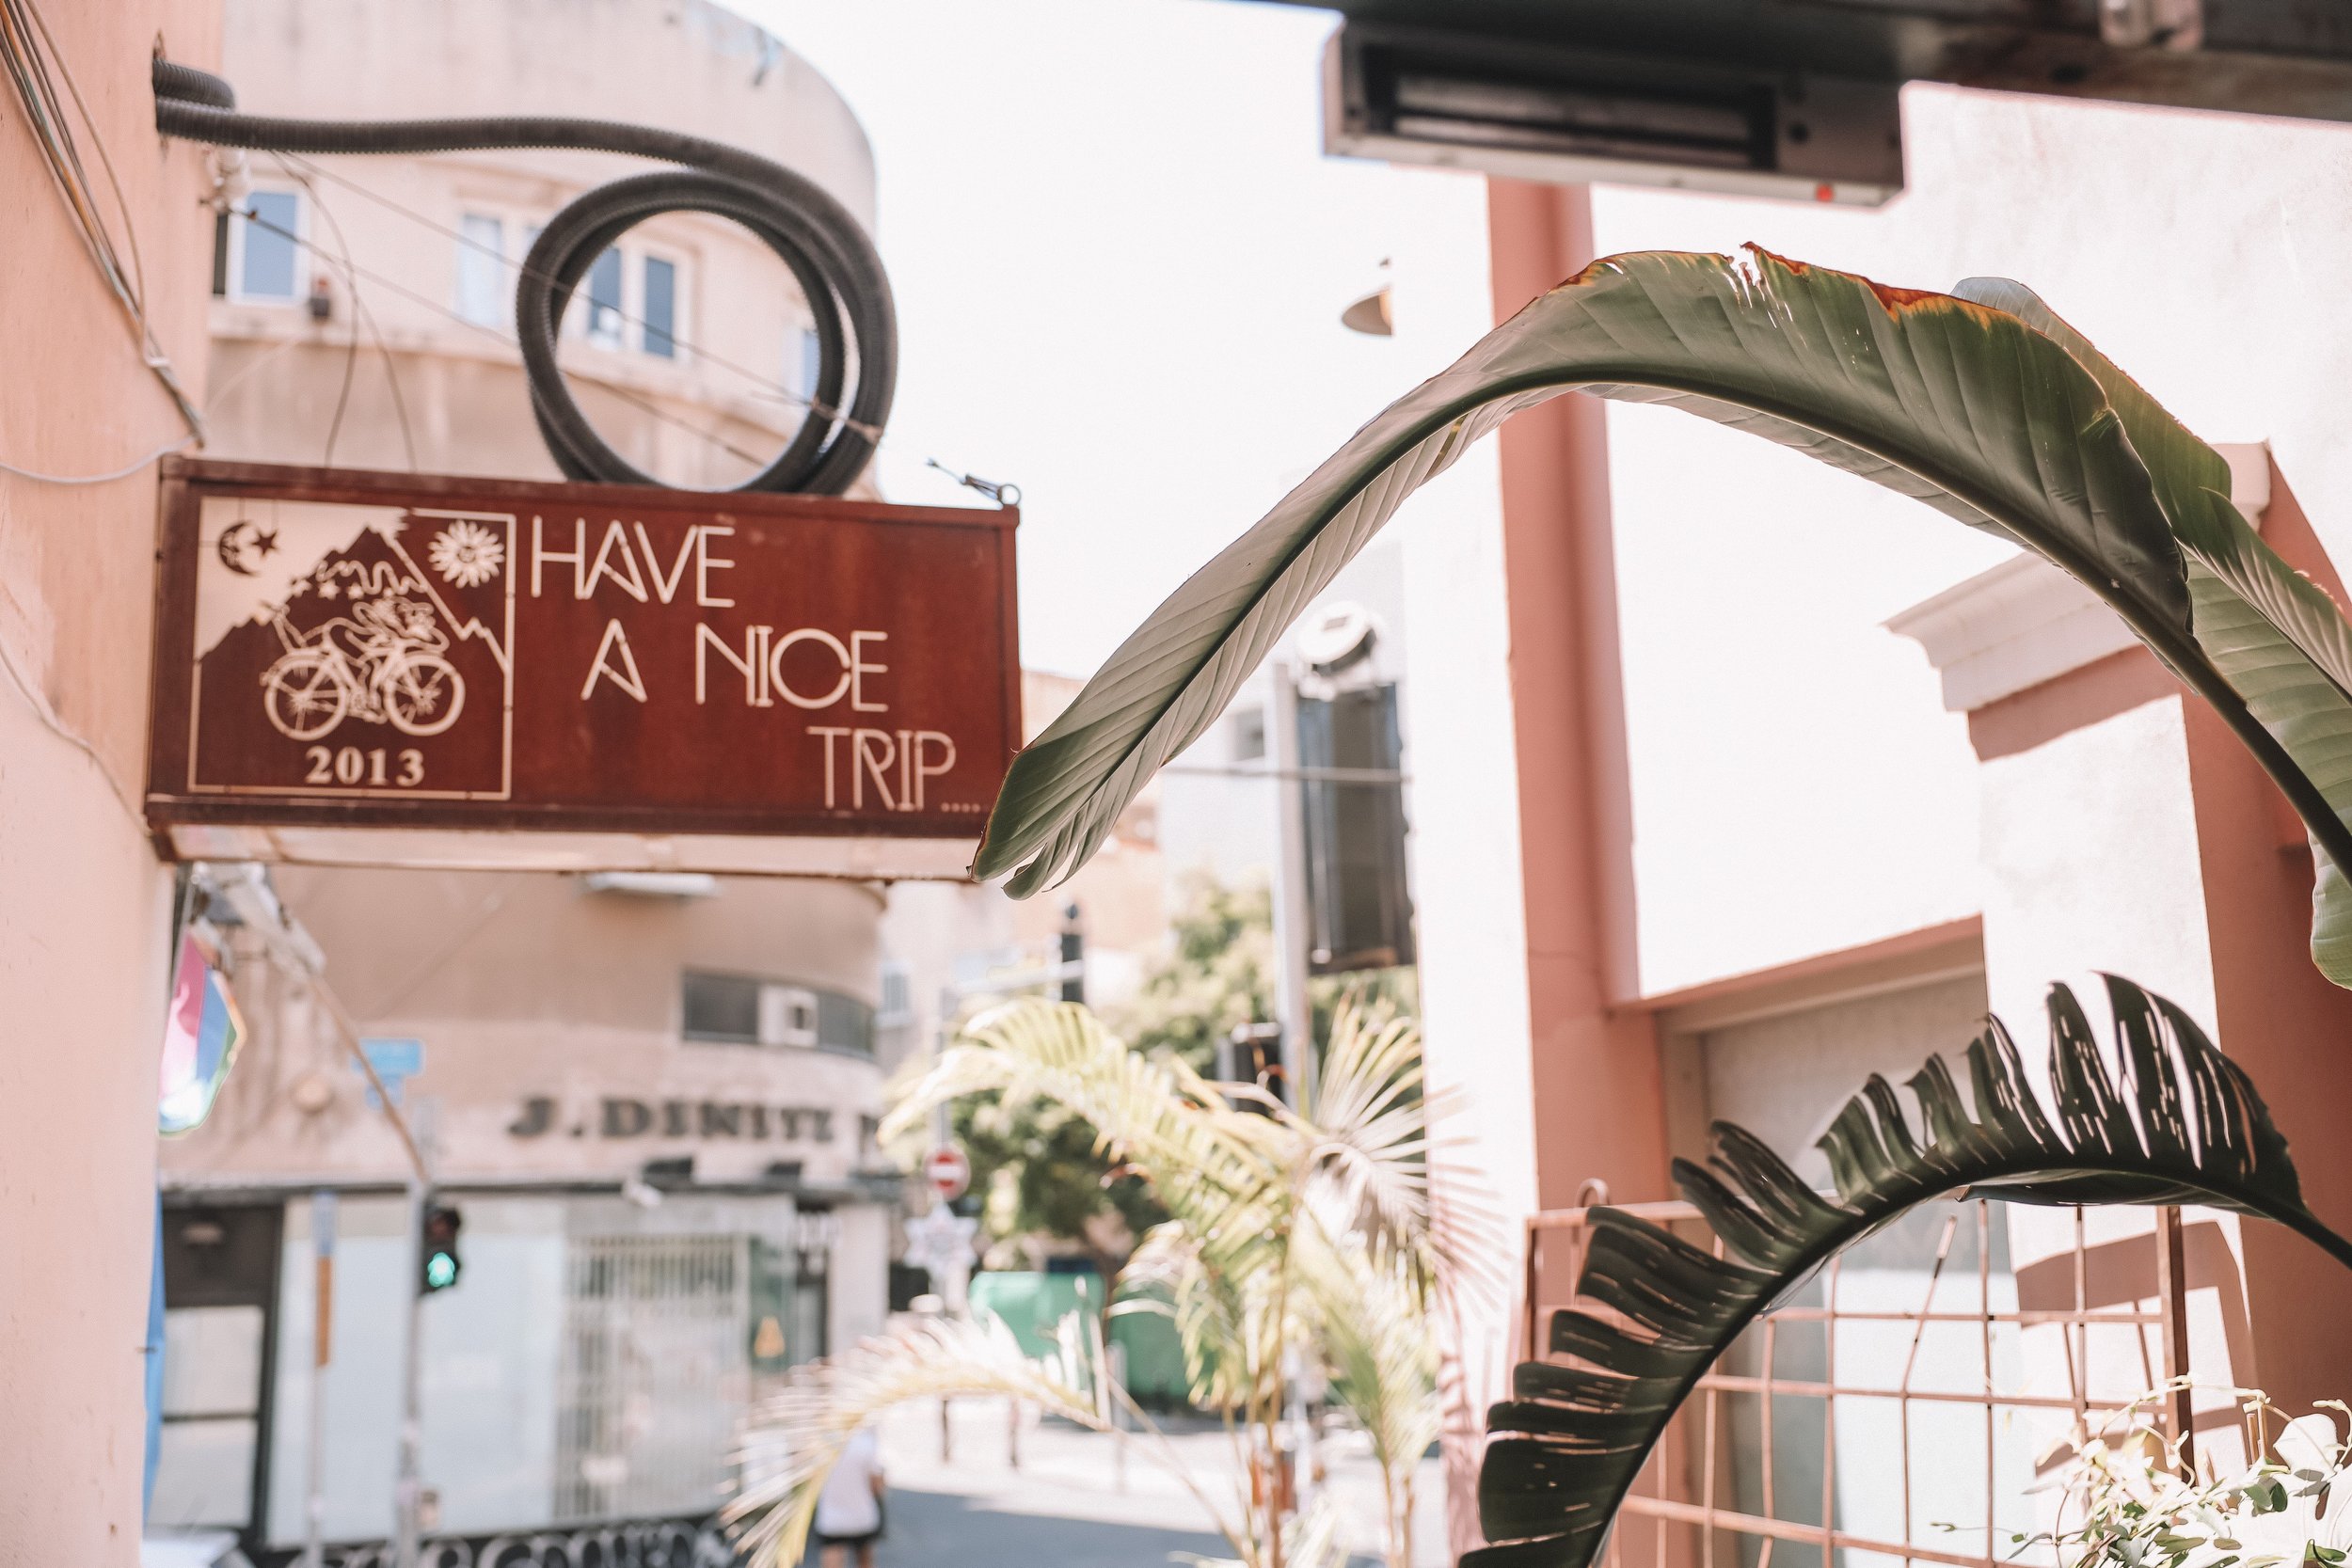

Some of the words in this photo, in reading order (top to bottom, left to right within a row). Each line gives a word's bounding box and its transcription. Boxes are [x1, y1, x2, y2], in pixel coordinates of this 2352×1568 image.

[530, 515, 738, 610] HAVE
[580, 617, 649, 704] A
[694, 621, 890, 713] NICE
[303, 744, 426, 788] 2013
